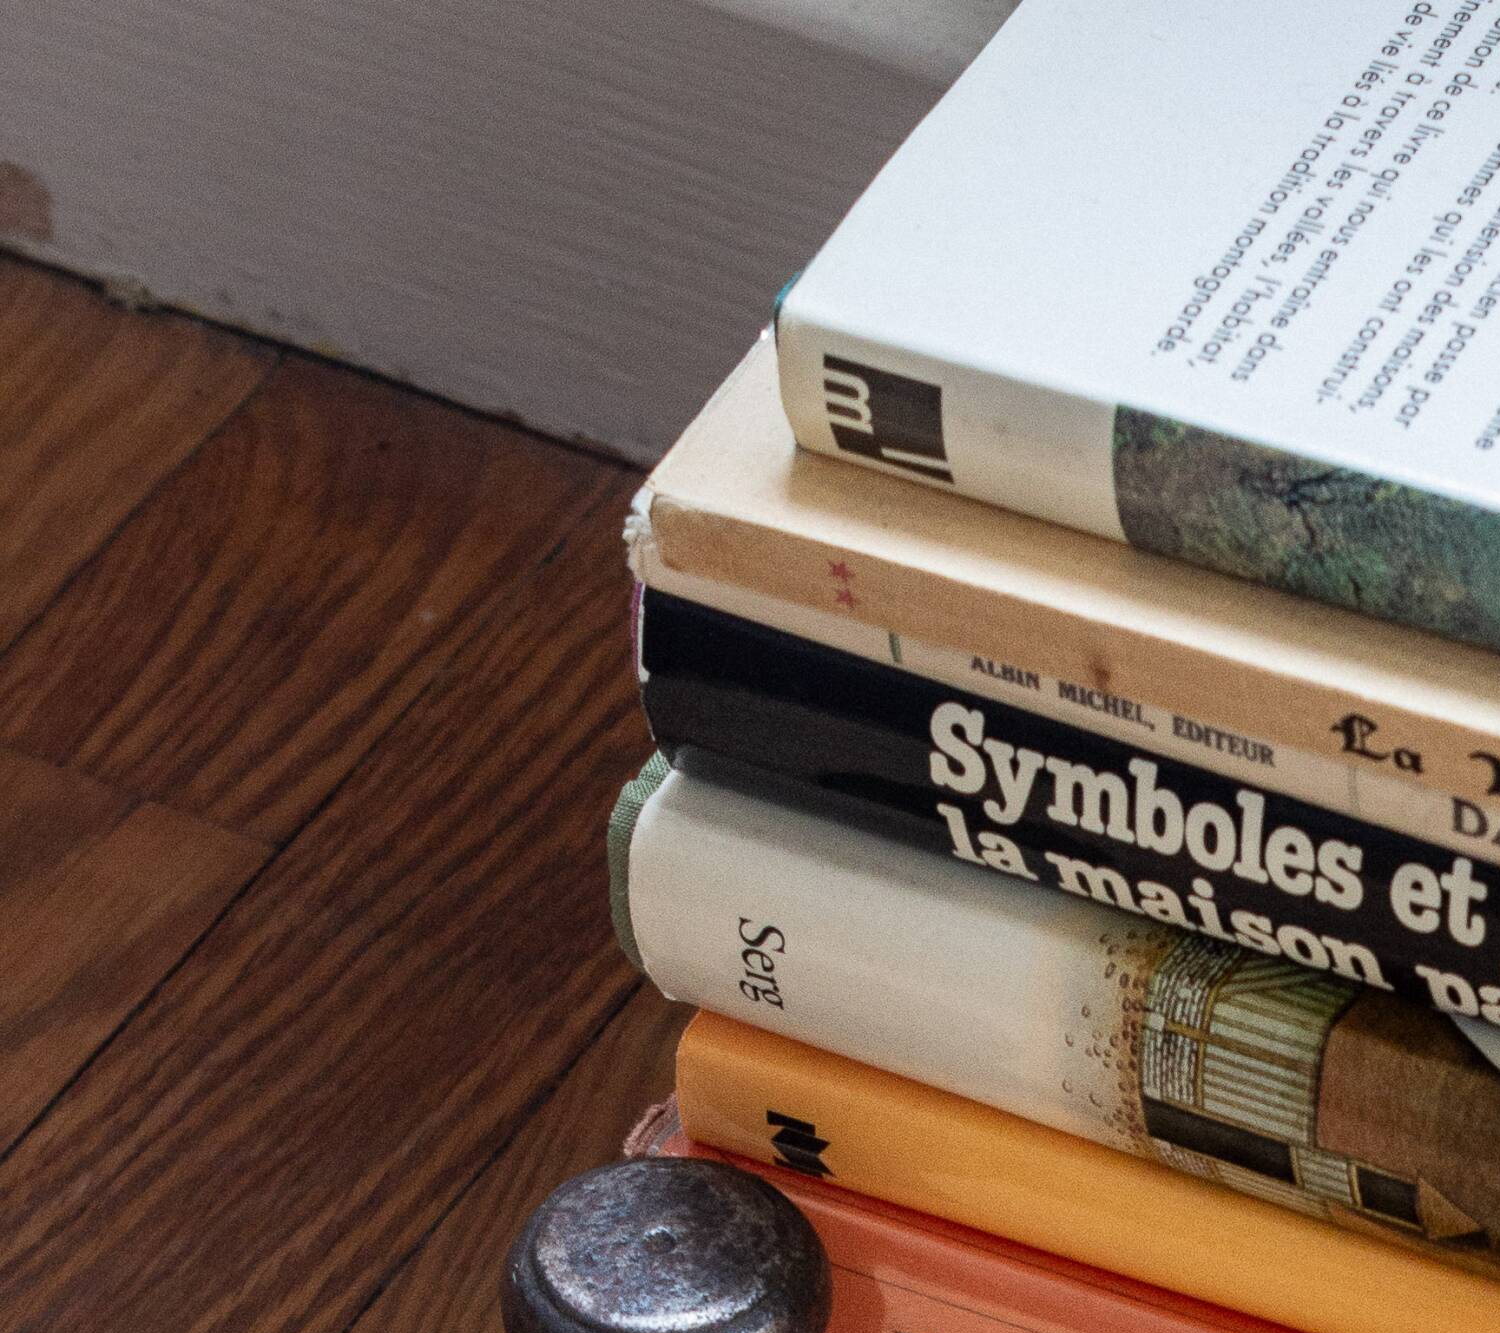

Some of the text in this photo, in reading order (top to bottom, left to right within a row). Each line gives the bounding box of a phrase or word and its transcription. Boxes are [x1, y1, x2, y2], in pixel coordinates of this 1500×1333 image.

[1150, 0, 1438, 356] de vie liés à la tradition montagnarde.
[1186, 71, 1432, 367] à travers les vallées, l'habitat,
[1229, 71, 1478, 382] de ce livre qui nous entraîne dans
[1404, 246, 1447, 275] les
[1428, 210, 1464, 245] qui
[1377, 278, 1413, 313] ont
[1415, 289, 1458, 325] des
[1315, 316, 1386, 404] construi-
[1347, 326, 1426, 413] maisons,
[1422, 320, 1478, 384] passe
[1394, 385, 1432, 429] par
[971, 655, 1276, 768] ALBIN MICHEL, EDITEUR
[1332, 712, 1424, 774] La
[929, 701, 1365, 912] Symboles
[1390, 857, 1489, 948] et
[937, 804, 1040, 884] la
[1045, 850, 1395, 992] maison
[738, 915, 787, 1011] Serg
